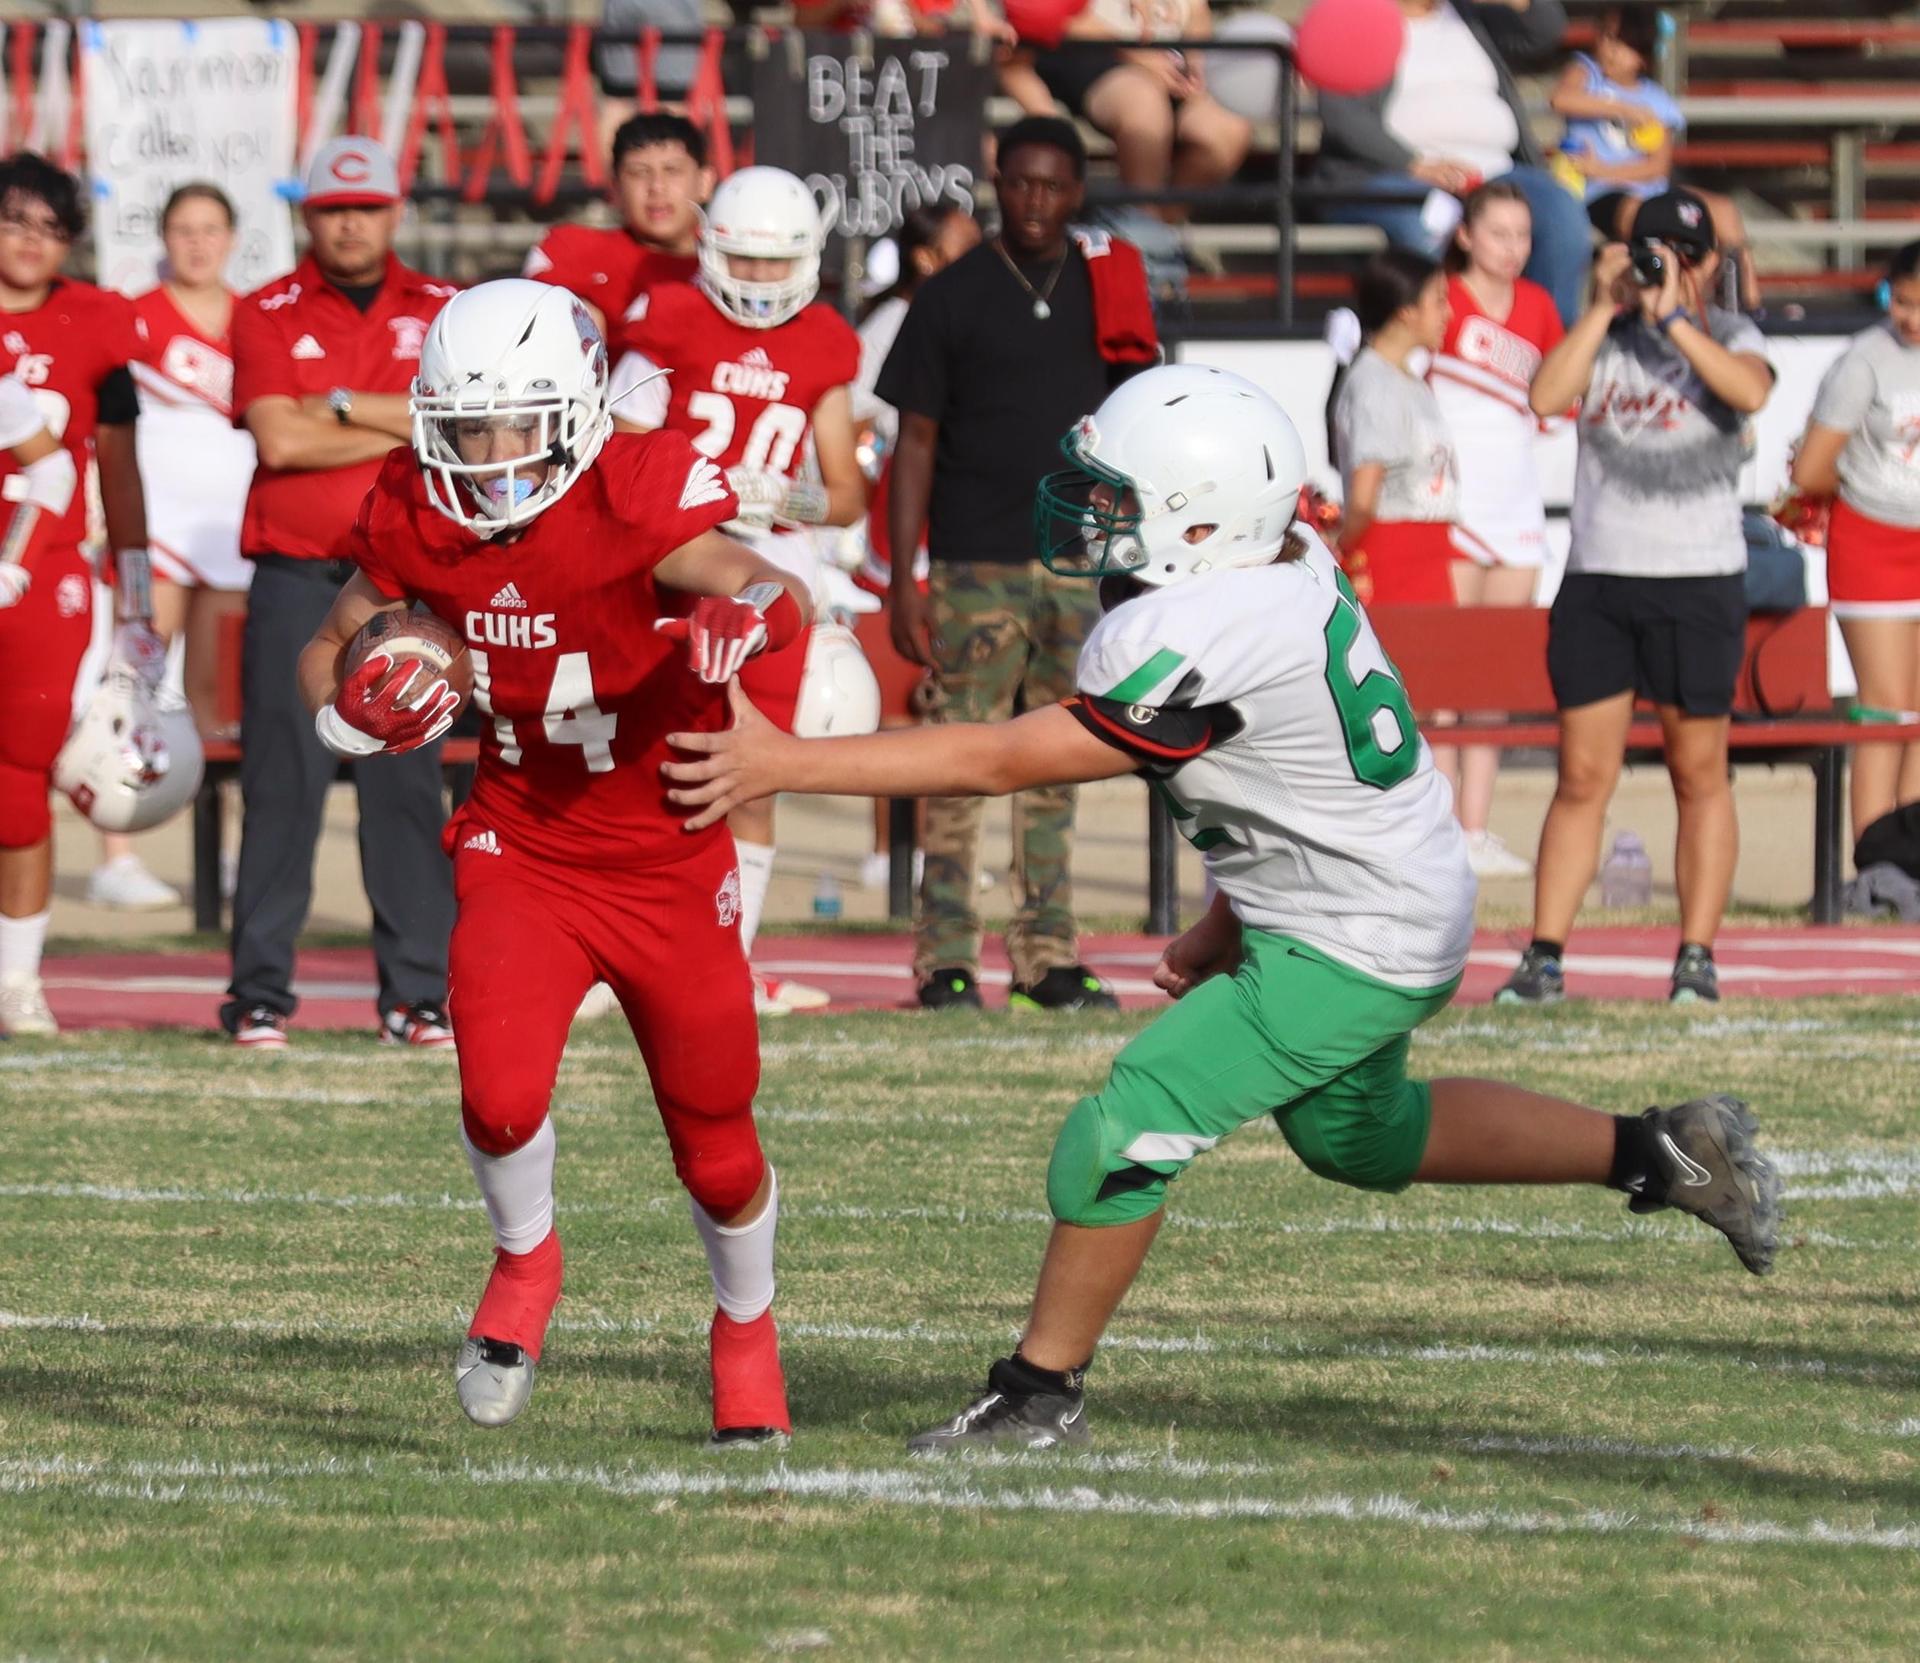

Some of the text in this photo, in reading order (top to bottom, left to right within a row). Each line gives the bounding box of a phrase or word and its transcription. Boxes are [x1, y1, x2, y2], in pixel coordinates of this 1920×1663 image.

[808, 51, 949, 123] BEAT
[330, 153, 369, 183] C
[839, 113, 915, 175] THE
[490, 597, 527, 609] adidas
[466, 610, 557, 649] CUHS
[468, 649, 618, 773] 14
